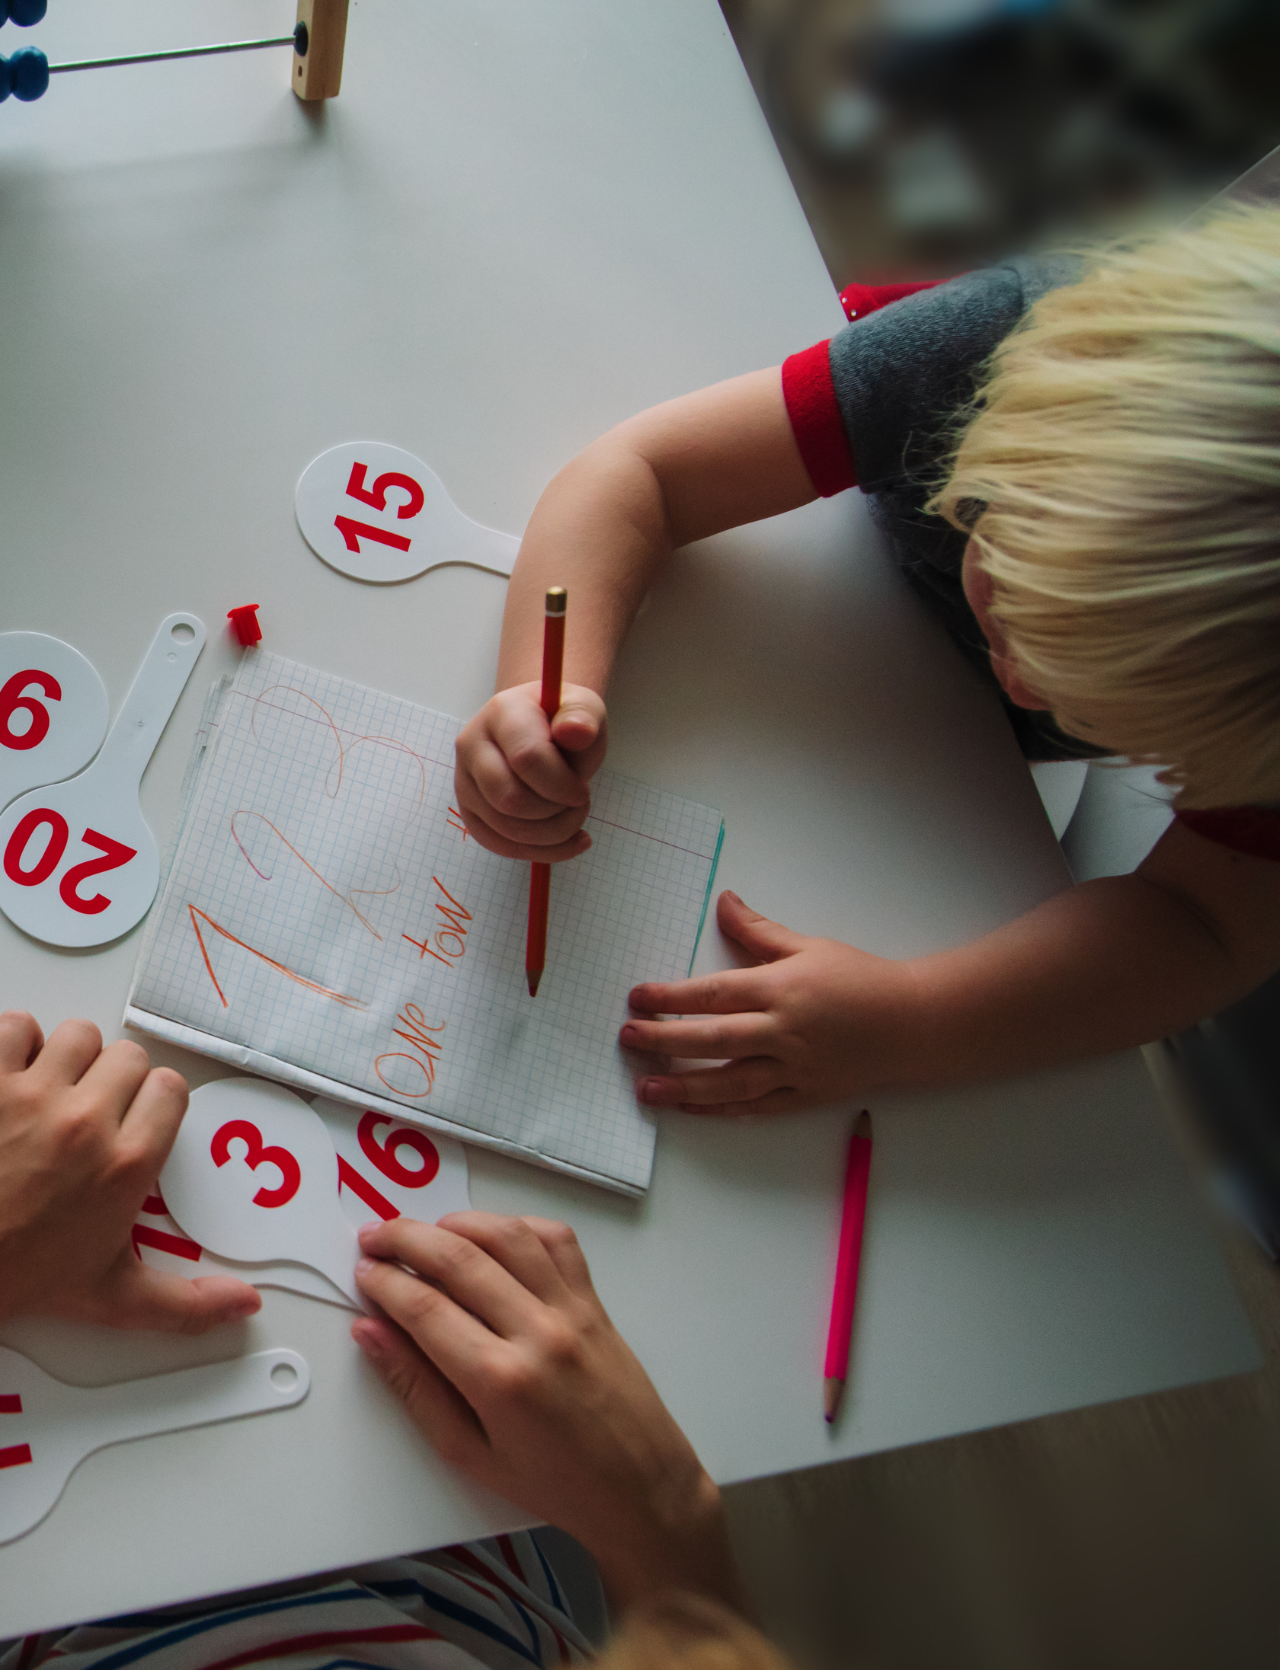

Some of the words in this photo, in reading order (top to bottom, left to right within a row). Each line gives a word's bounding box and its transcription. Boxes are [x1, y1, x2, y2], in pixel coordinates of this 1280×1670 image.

[334, 462, 426, 553] 15
[3, 807, 138, 915] 20
[210, 1119, 301, 1209] 3
[337, 1110, 441, 1221] 16
